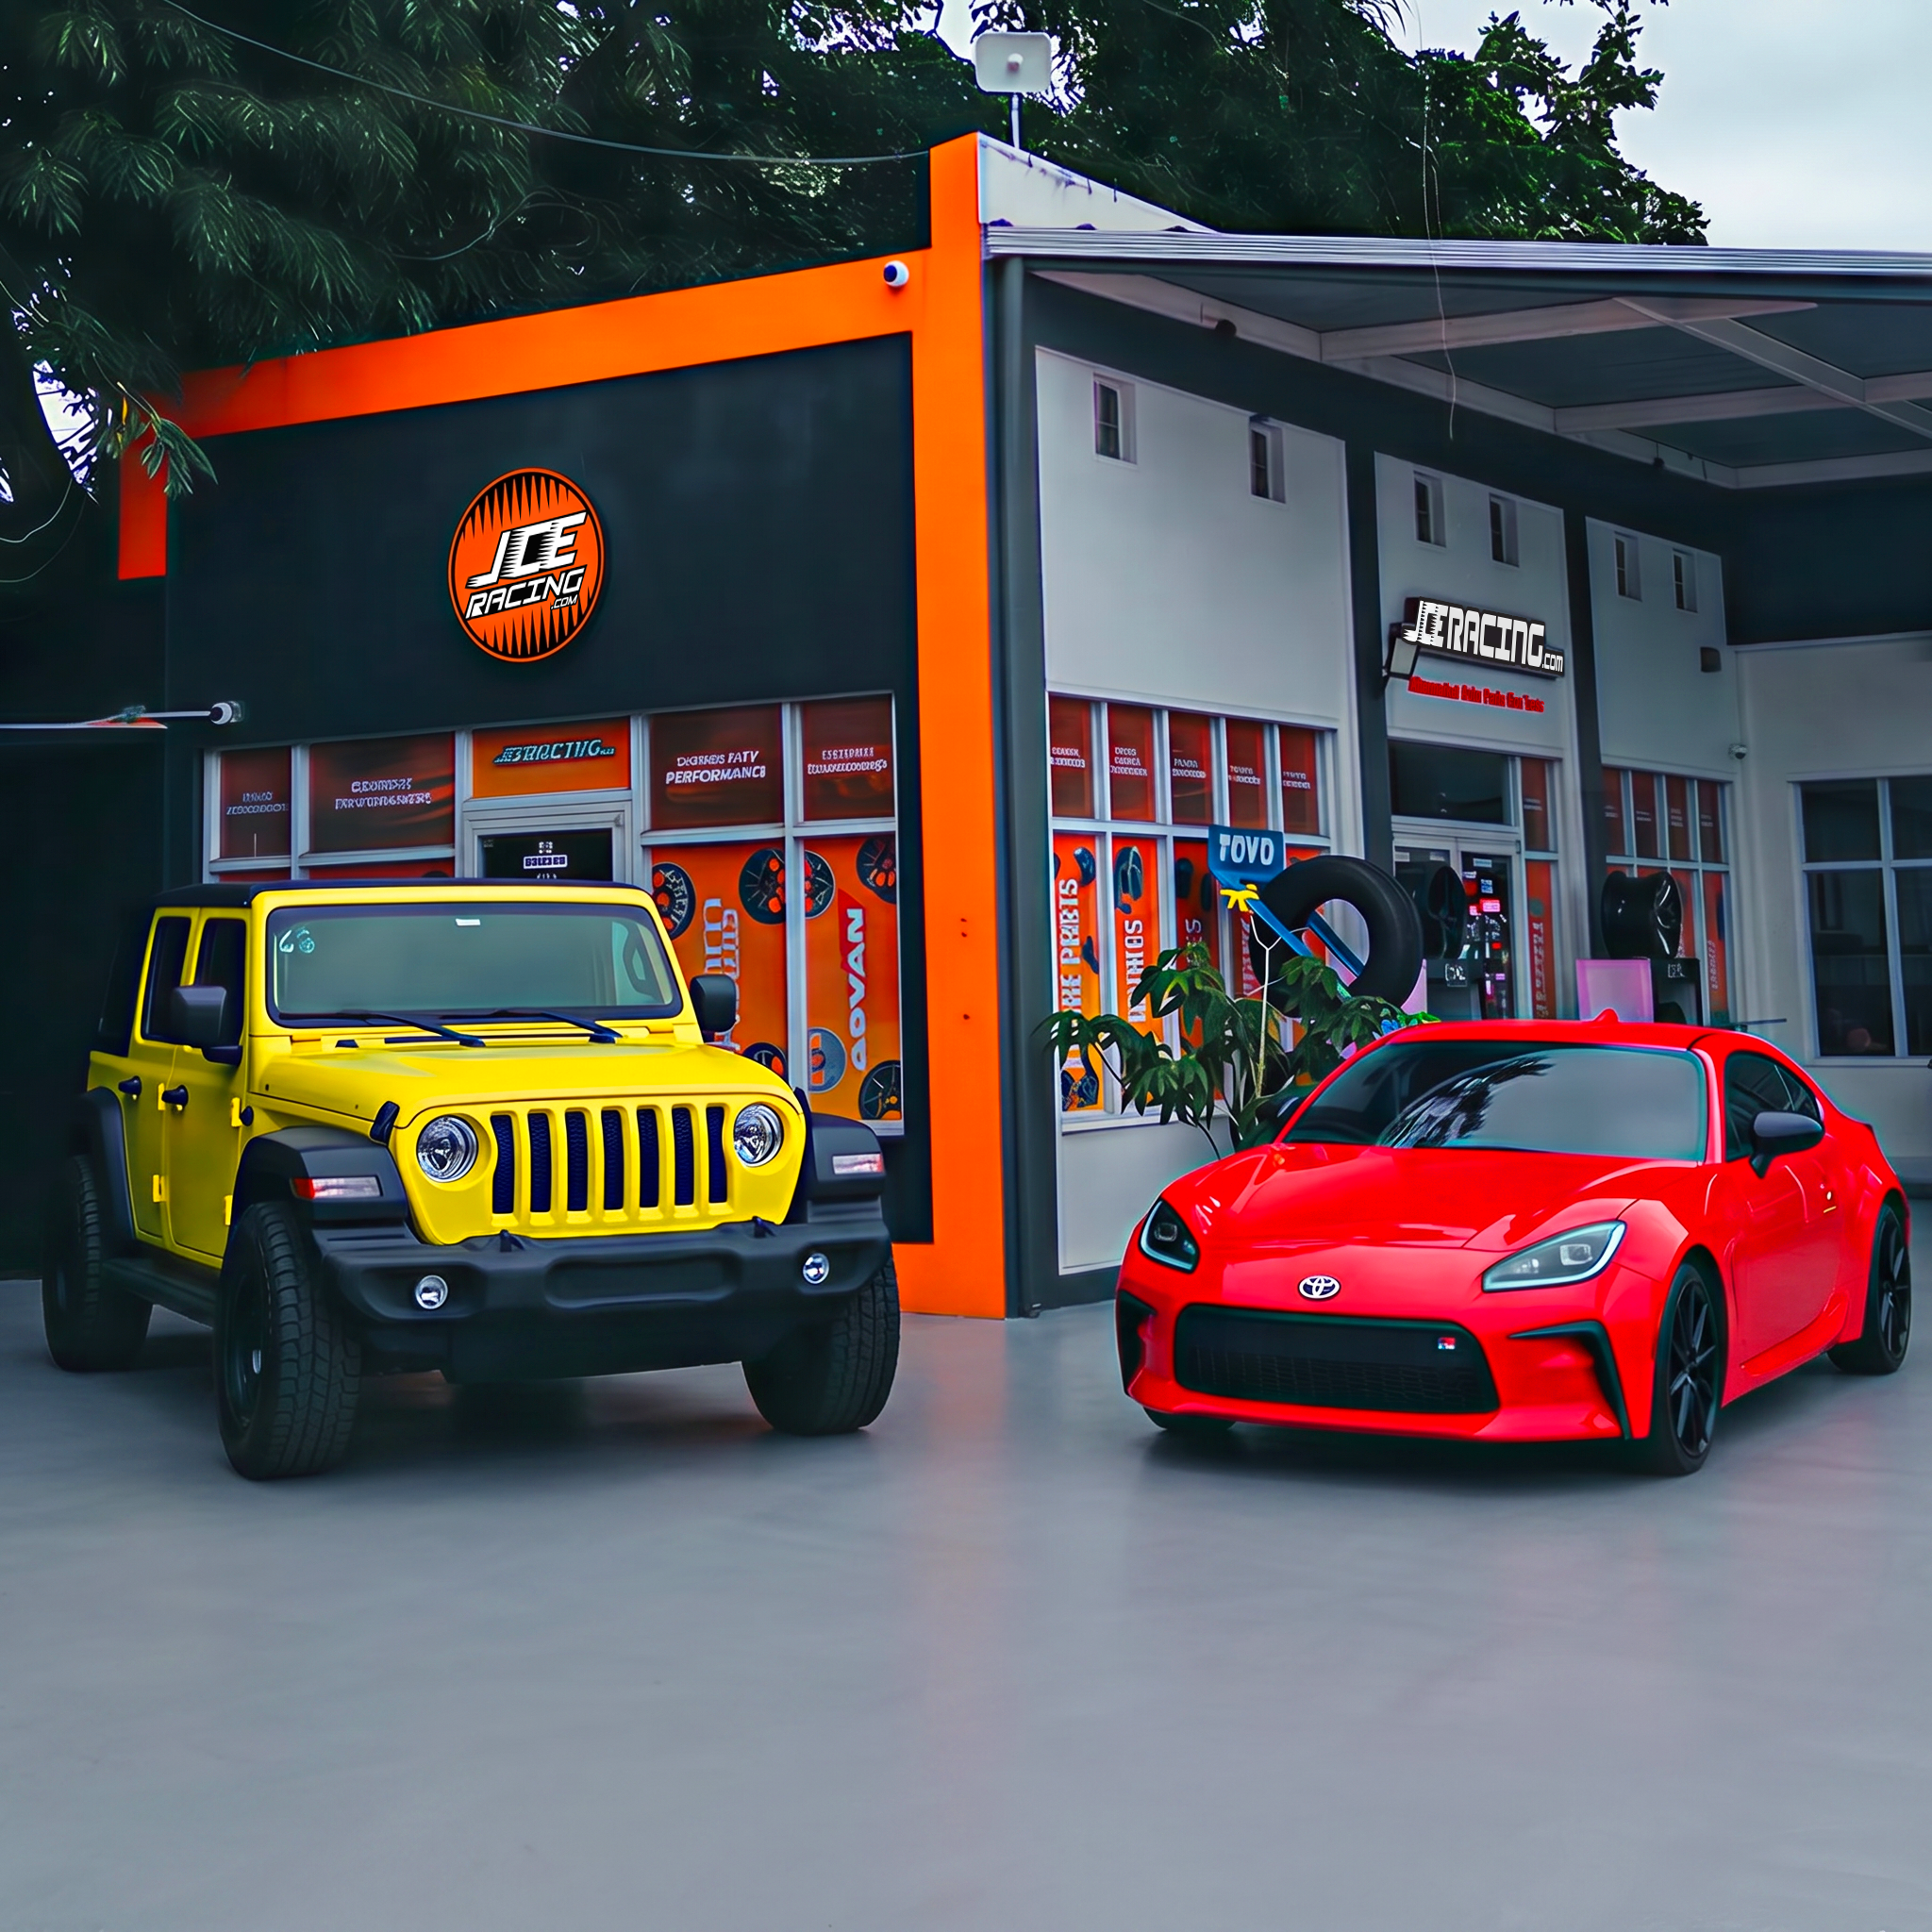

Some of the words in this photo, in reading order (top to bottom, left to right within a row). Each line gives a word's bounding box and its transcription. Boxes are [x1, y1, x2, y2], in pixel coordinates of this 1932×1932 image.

[465, 566, 586, 620] RACING
[1461, 685, 1482, 704] Auto
[1483, 688, 1506, 708] Parts
[1507, 691, 1524, 710] For
